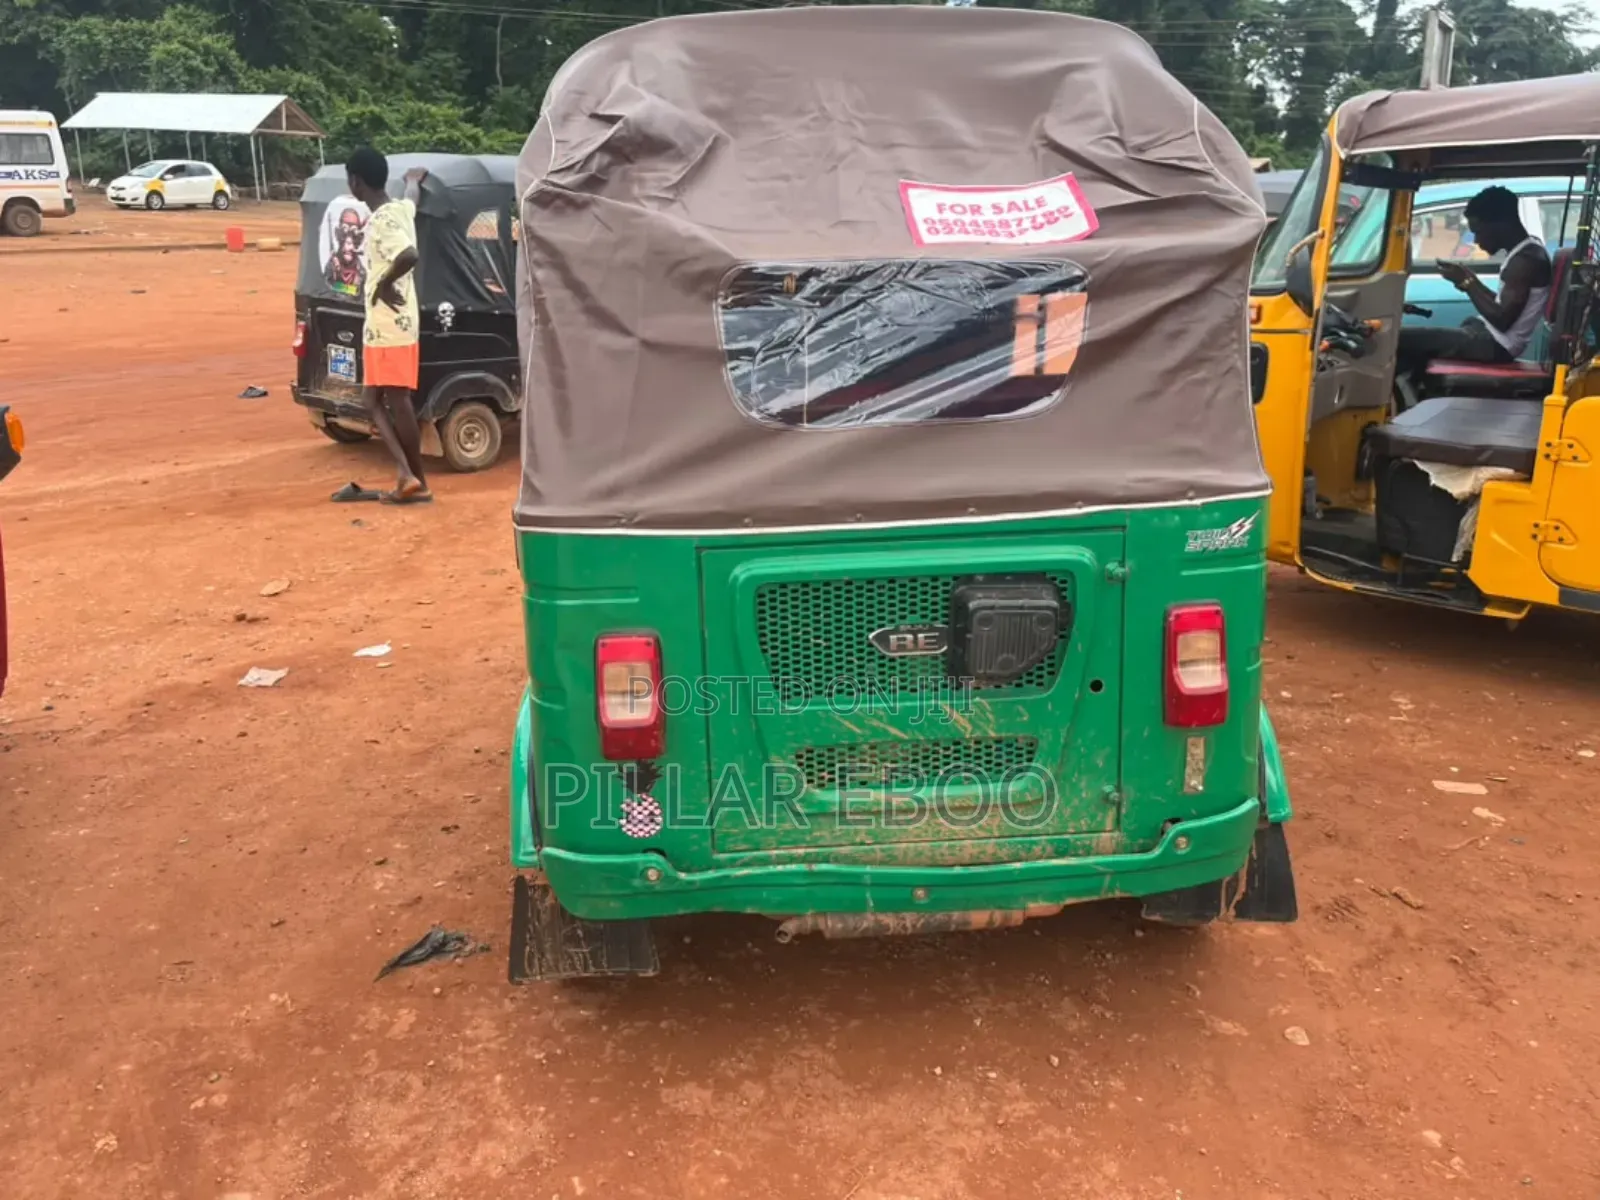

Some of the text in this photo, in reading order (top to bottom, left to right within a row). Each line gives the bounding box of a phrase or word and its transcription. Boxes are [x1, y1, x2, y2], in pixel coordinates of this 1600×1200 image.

[11, 170, 50, 180] AKS
[936, 196, 1048, 217] FOR SALE
[889, 632, 939, 651] RE
